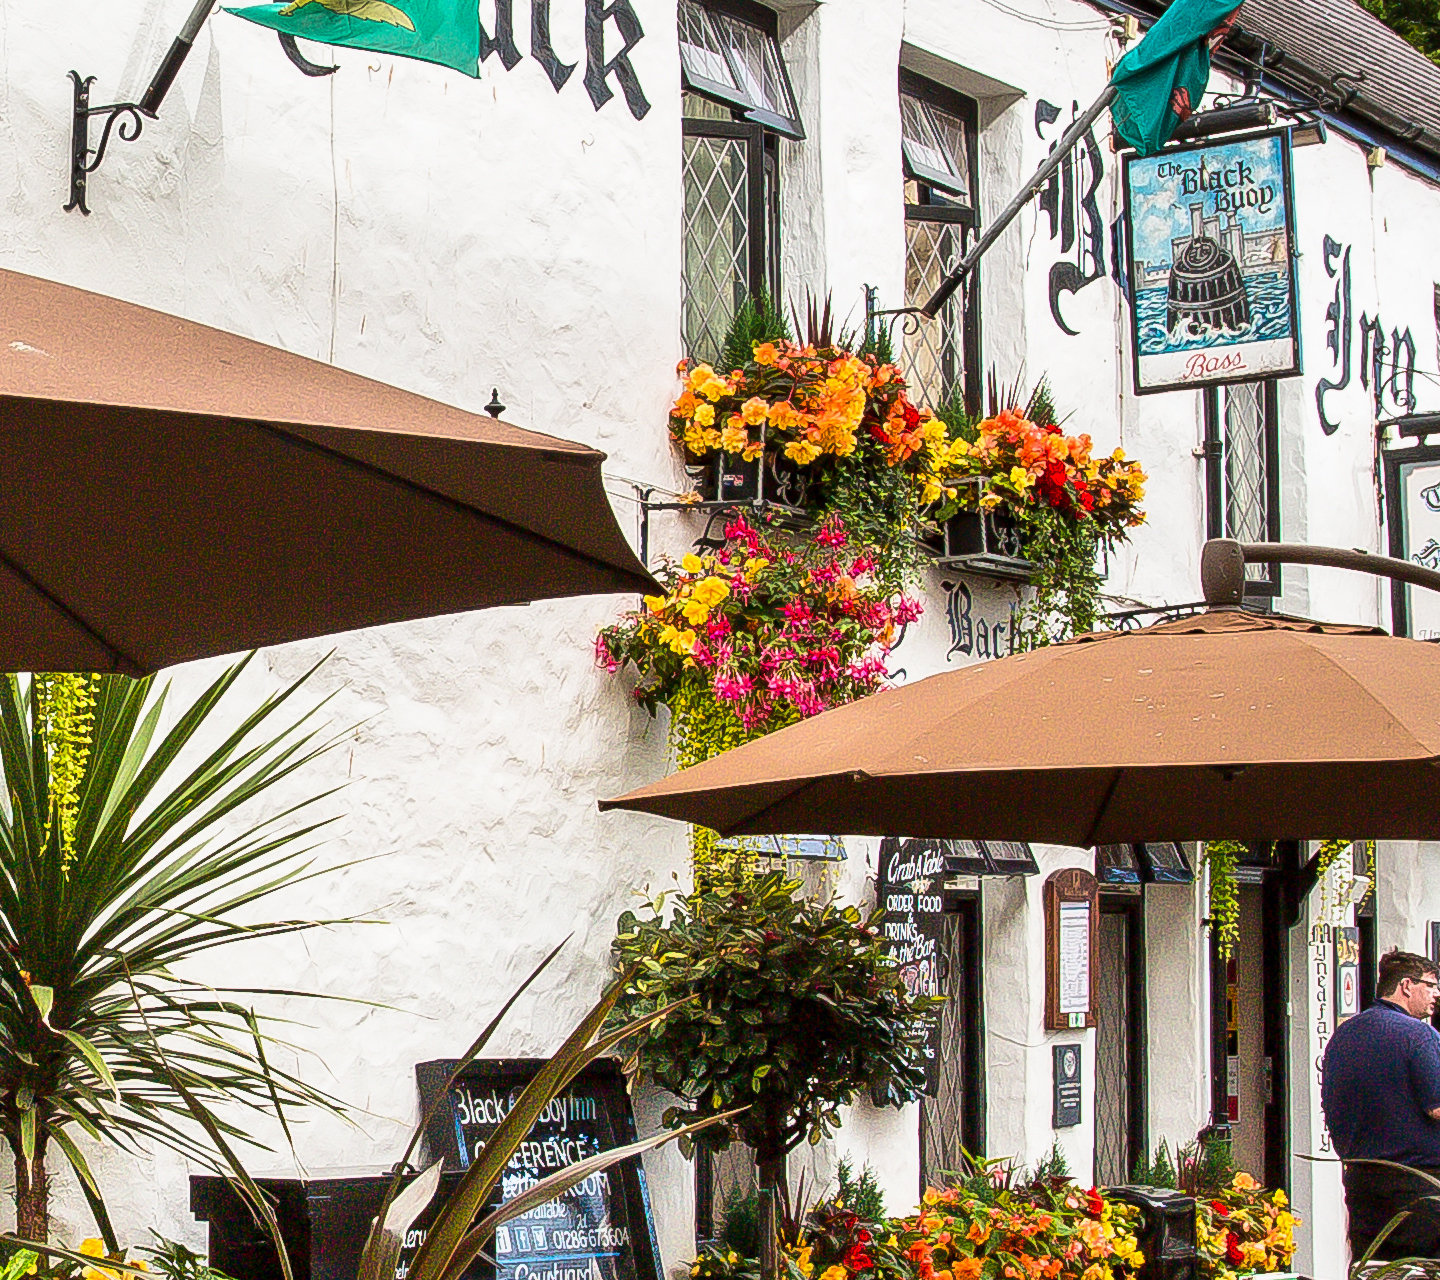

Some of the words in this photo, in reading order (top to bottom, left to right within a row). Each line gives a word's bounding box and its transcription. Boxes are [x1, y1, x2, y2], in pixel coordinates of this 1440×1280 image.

[1157, 162, 1182, 178] The
[1182, 161, 1255, 196] Black
[1215, 185, 1274, 214] Buoy
[1316, 234, 1416, 436] Inn
[1183, 351, 1246, 379] Bass
[888, 852, 915, 883] Grab
[887, 894, 914, 912] ORDER
[918, 895, 942, 912] FOOD
[885, 923, 918, 942] DRINKS
[915, 934, 935, 959] Bar
